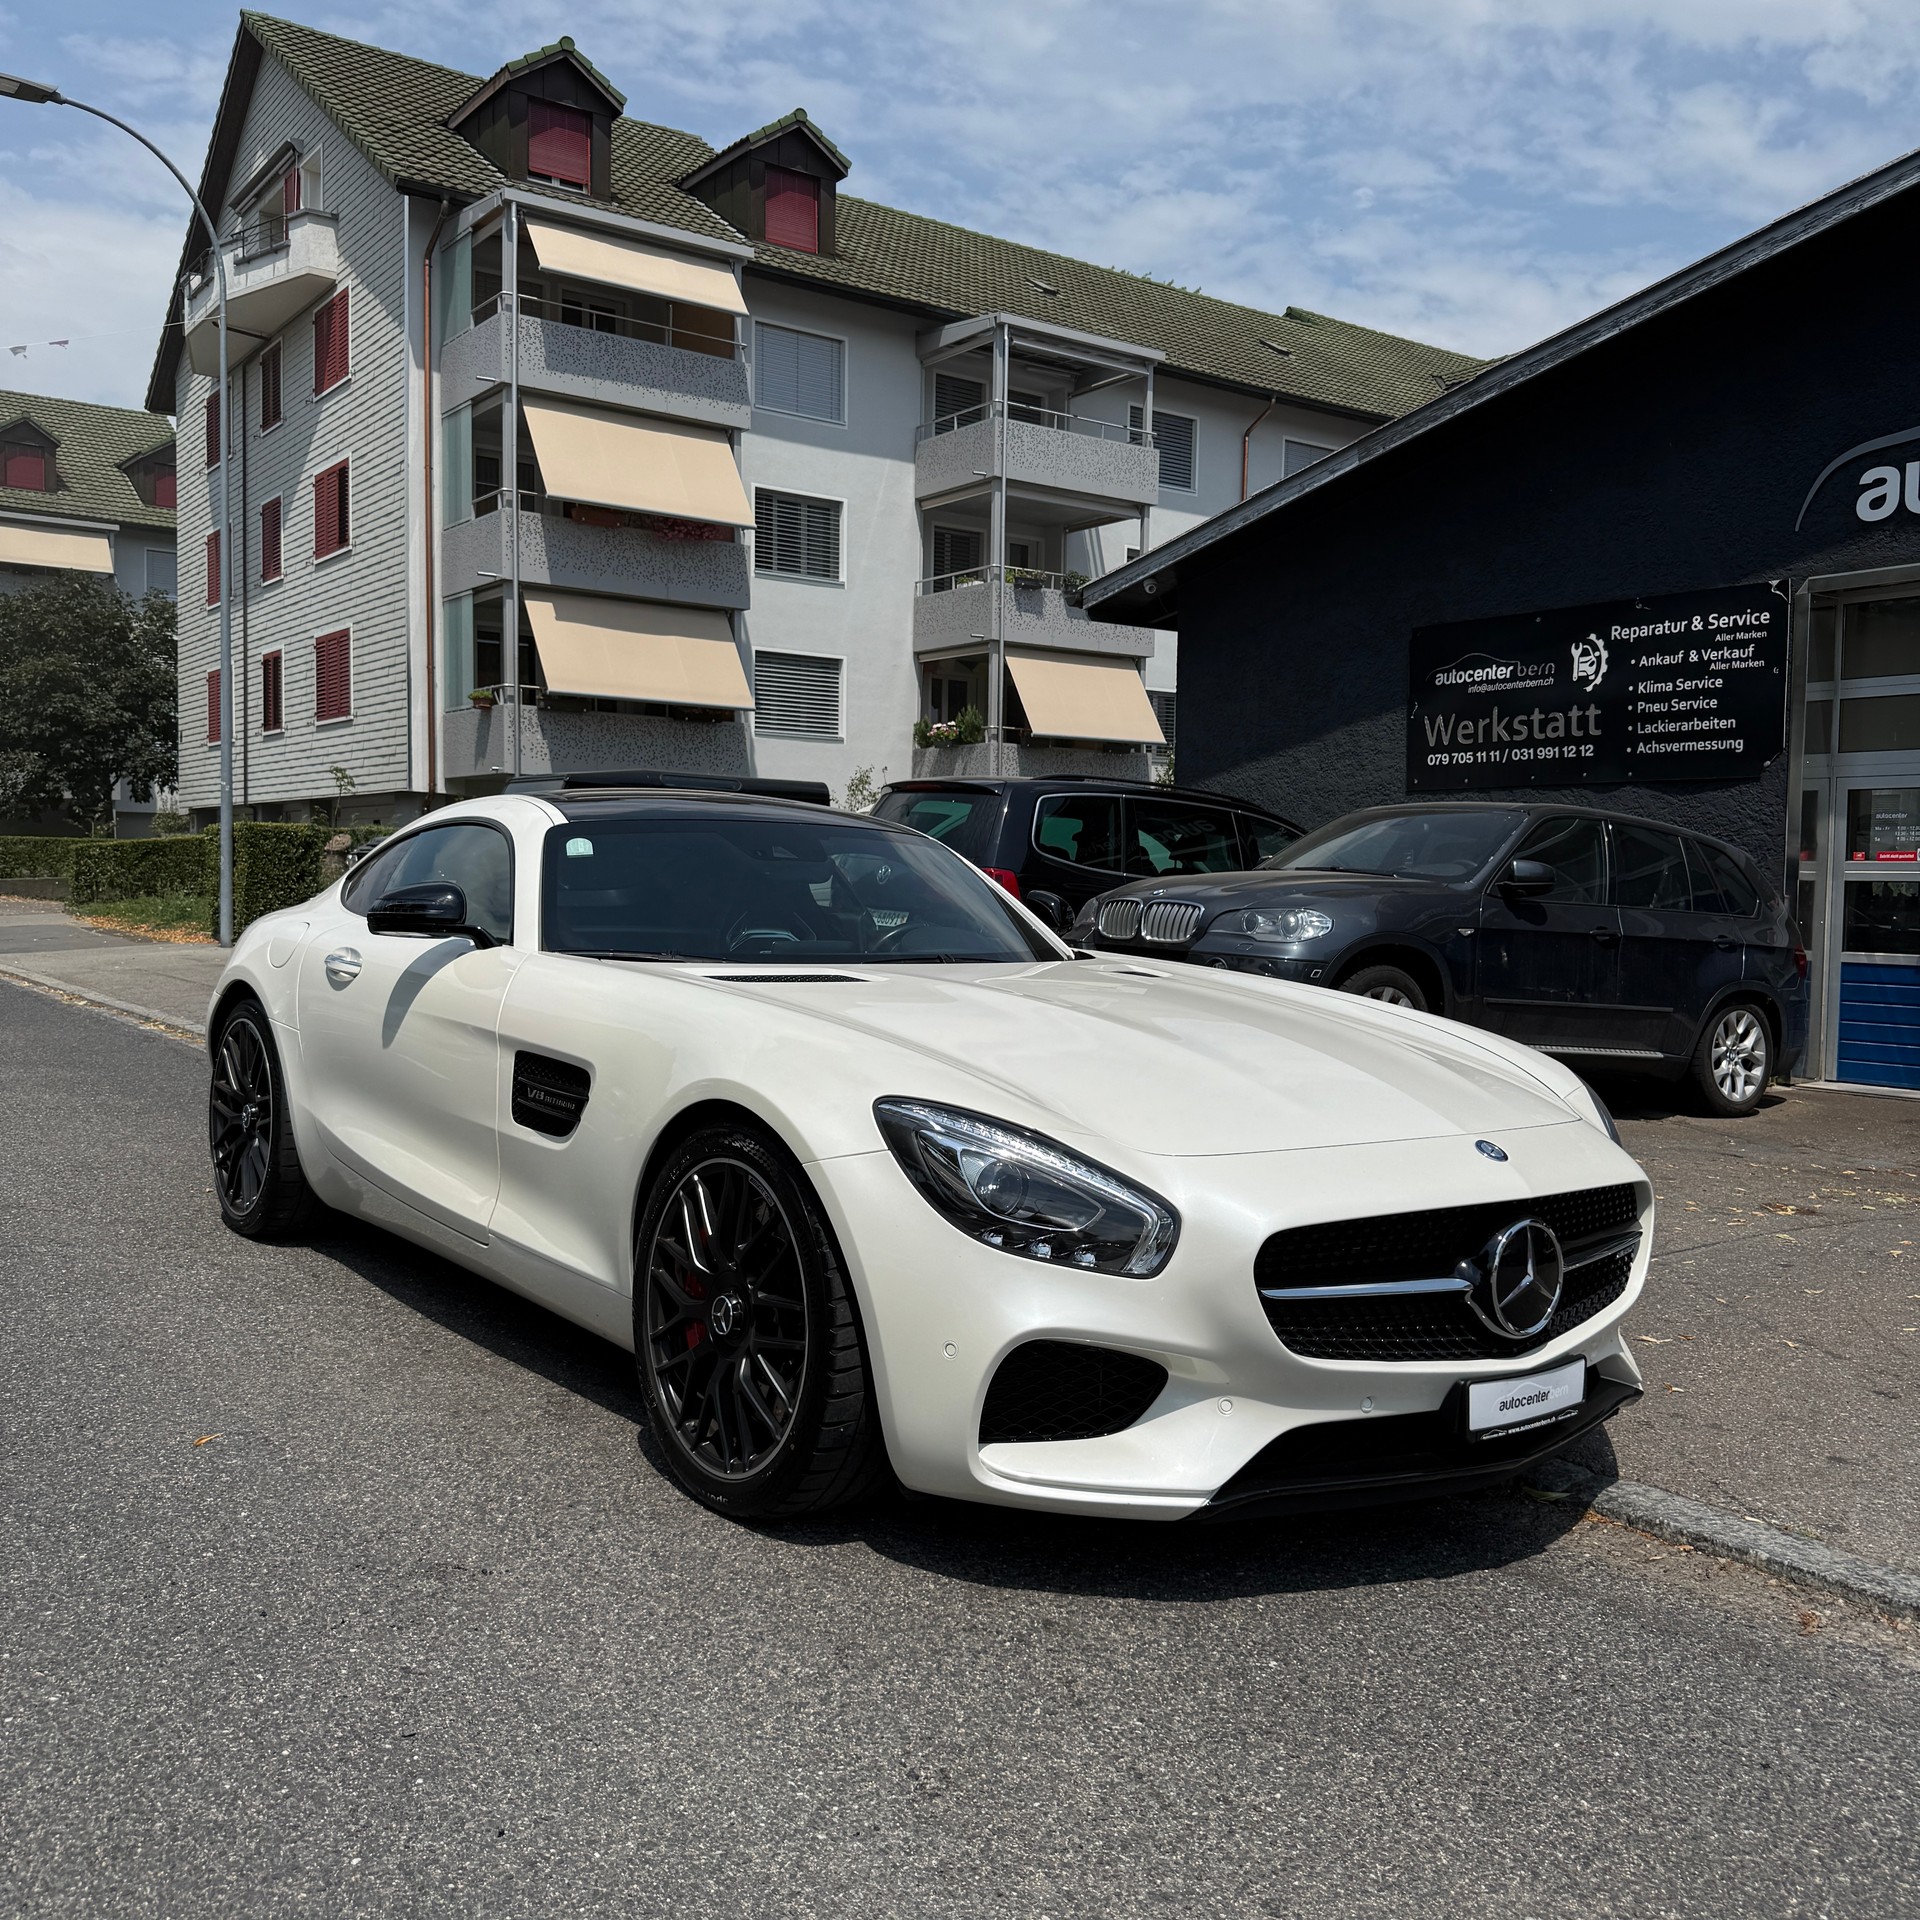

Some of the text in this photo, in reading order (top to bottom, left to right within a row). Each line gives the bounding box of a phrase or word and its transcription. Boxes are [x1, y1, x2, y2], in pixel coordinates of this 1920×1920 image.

[1611, 609, 1771, 643] Reparatur & Service
[1715, 630, 1768, 642] Aller Marken
[1639, 644, 1756, 667] Ankauf & Verkauf
[1709, 659, 1765, 671] Aller Marken
[1435, 664, 1514, 686] autocenter
[1467, 677, 1554, 694] info@autocenterbern.ch
[1638, 676, 1724, 694] Klima Service
[1637, 696, 1718, 714] Pneu Service
[1424, 703, 1602, 747] Werkstatt
[1637, 716, 1737, 734] Lackierarbeiten
[1427, 753, 1450, 766] 079
[1452, 752, 1474, 764] 705
[1476, 751, 1487, 763] 11
[1489, 750, 1500, 762] 11
[1511, 747, 1534, 760] 031
[1537, 746, 1560, 759] 991
[1562, 745, 1576, 758] 12
[1579, 744, 1594, 757] 12
[1636, 738, 1744, 754] Achsvermessung
[527, 1087, 545, 1100] V8
[1499, 1390, 1550, 1411] autocenter
